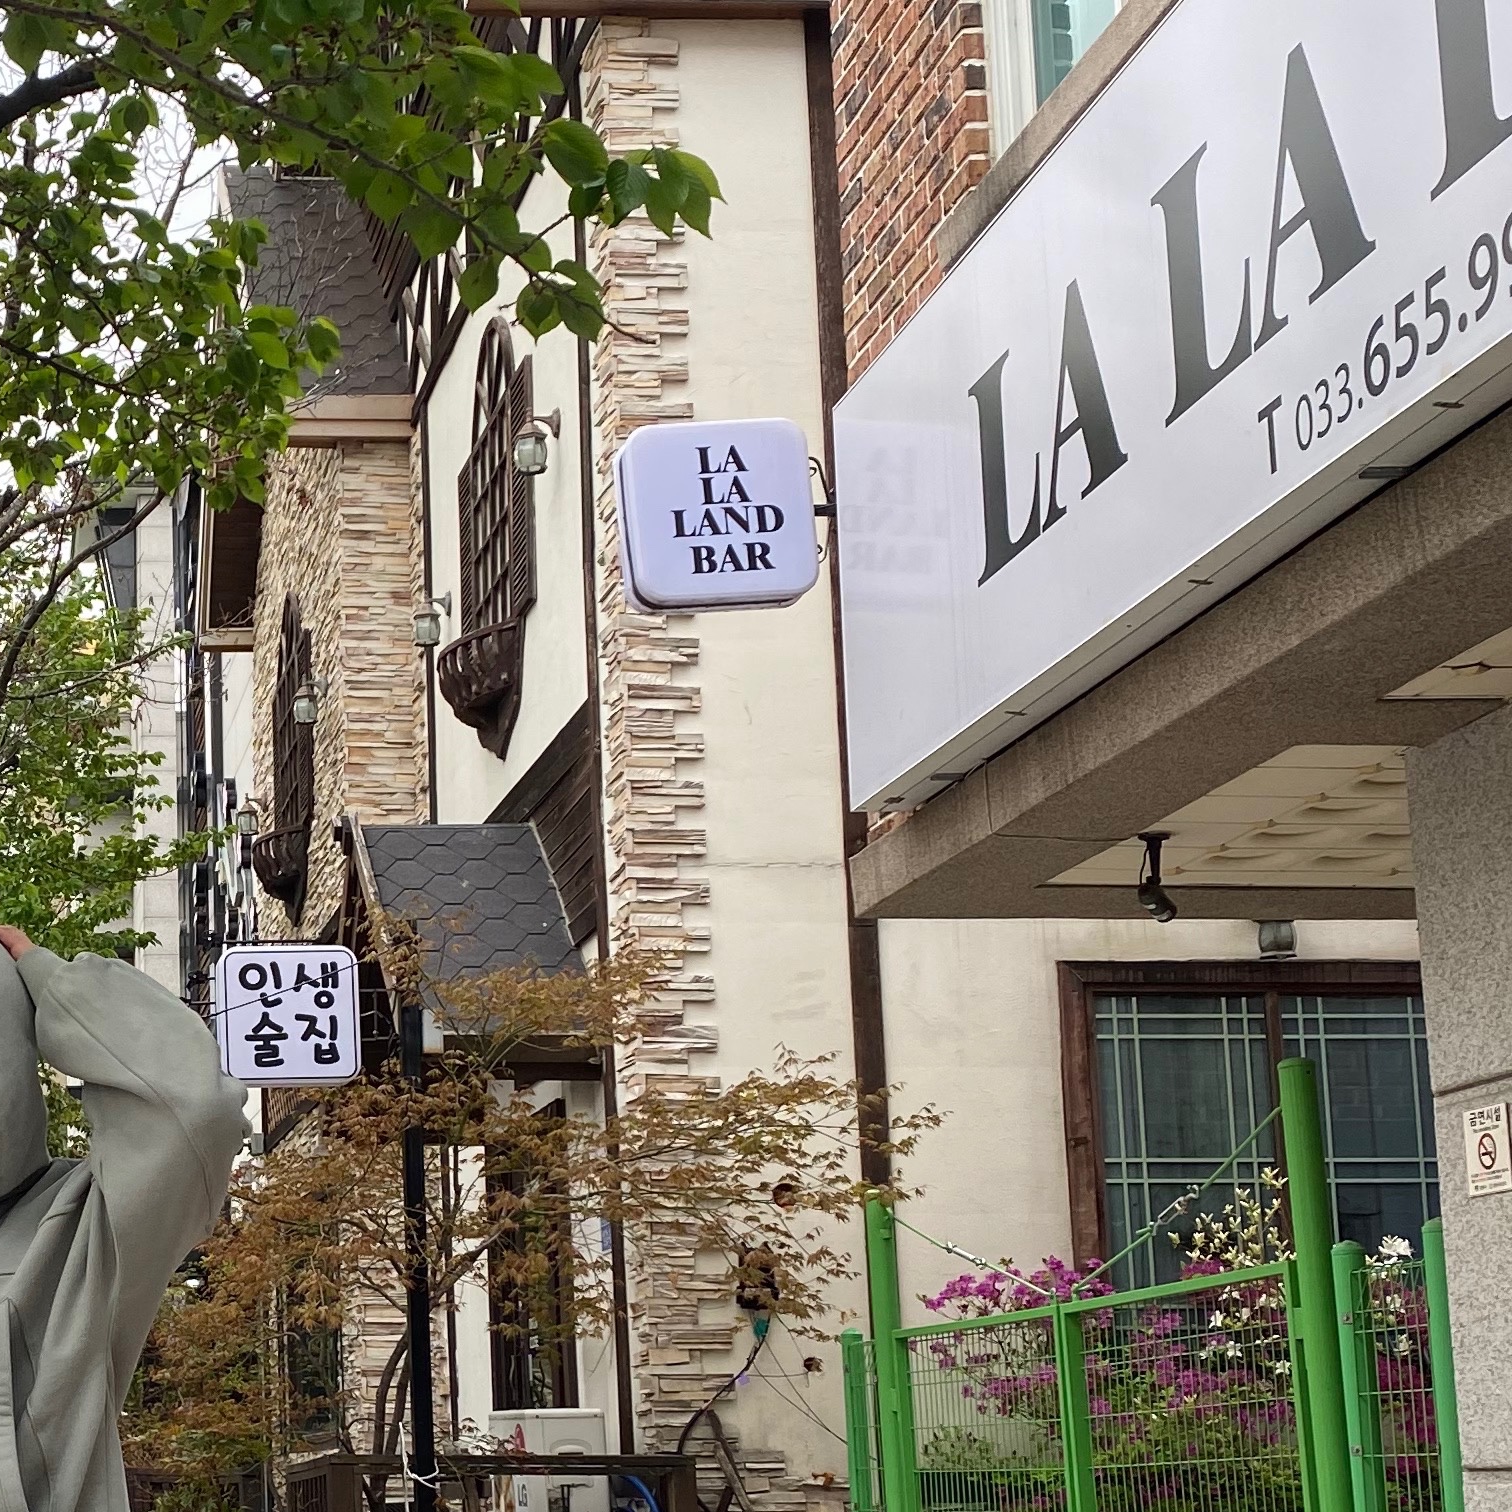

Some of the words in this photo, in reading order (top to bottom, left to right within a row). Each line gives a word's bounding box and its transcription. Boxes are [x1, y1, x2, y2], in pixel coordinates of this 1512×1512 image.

[968, 278, 1129, 588] LA
[1150, 41, 1377, 428] LA
[1257, 393, 1284, 475] T
[695, 444, 749, 475] LA
[699, 475, 752, 505] LA
[670, 504, 785, 538] LAND
[689, 541, 776, 575] BAR
[238, 960, 340, 1009] 인생
[244, 1011, 341, 1068] 술집
[1468, 1106, 1501, 1127] 금연시설
[517, 1483, 528, 1508] LG
